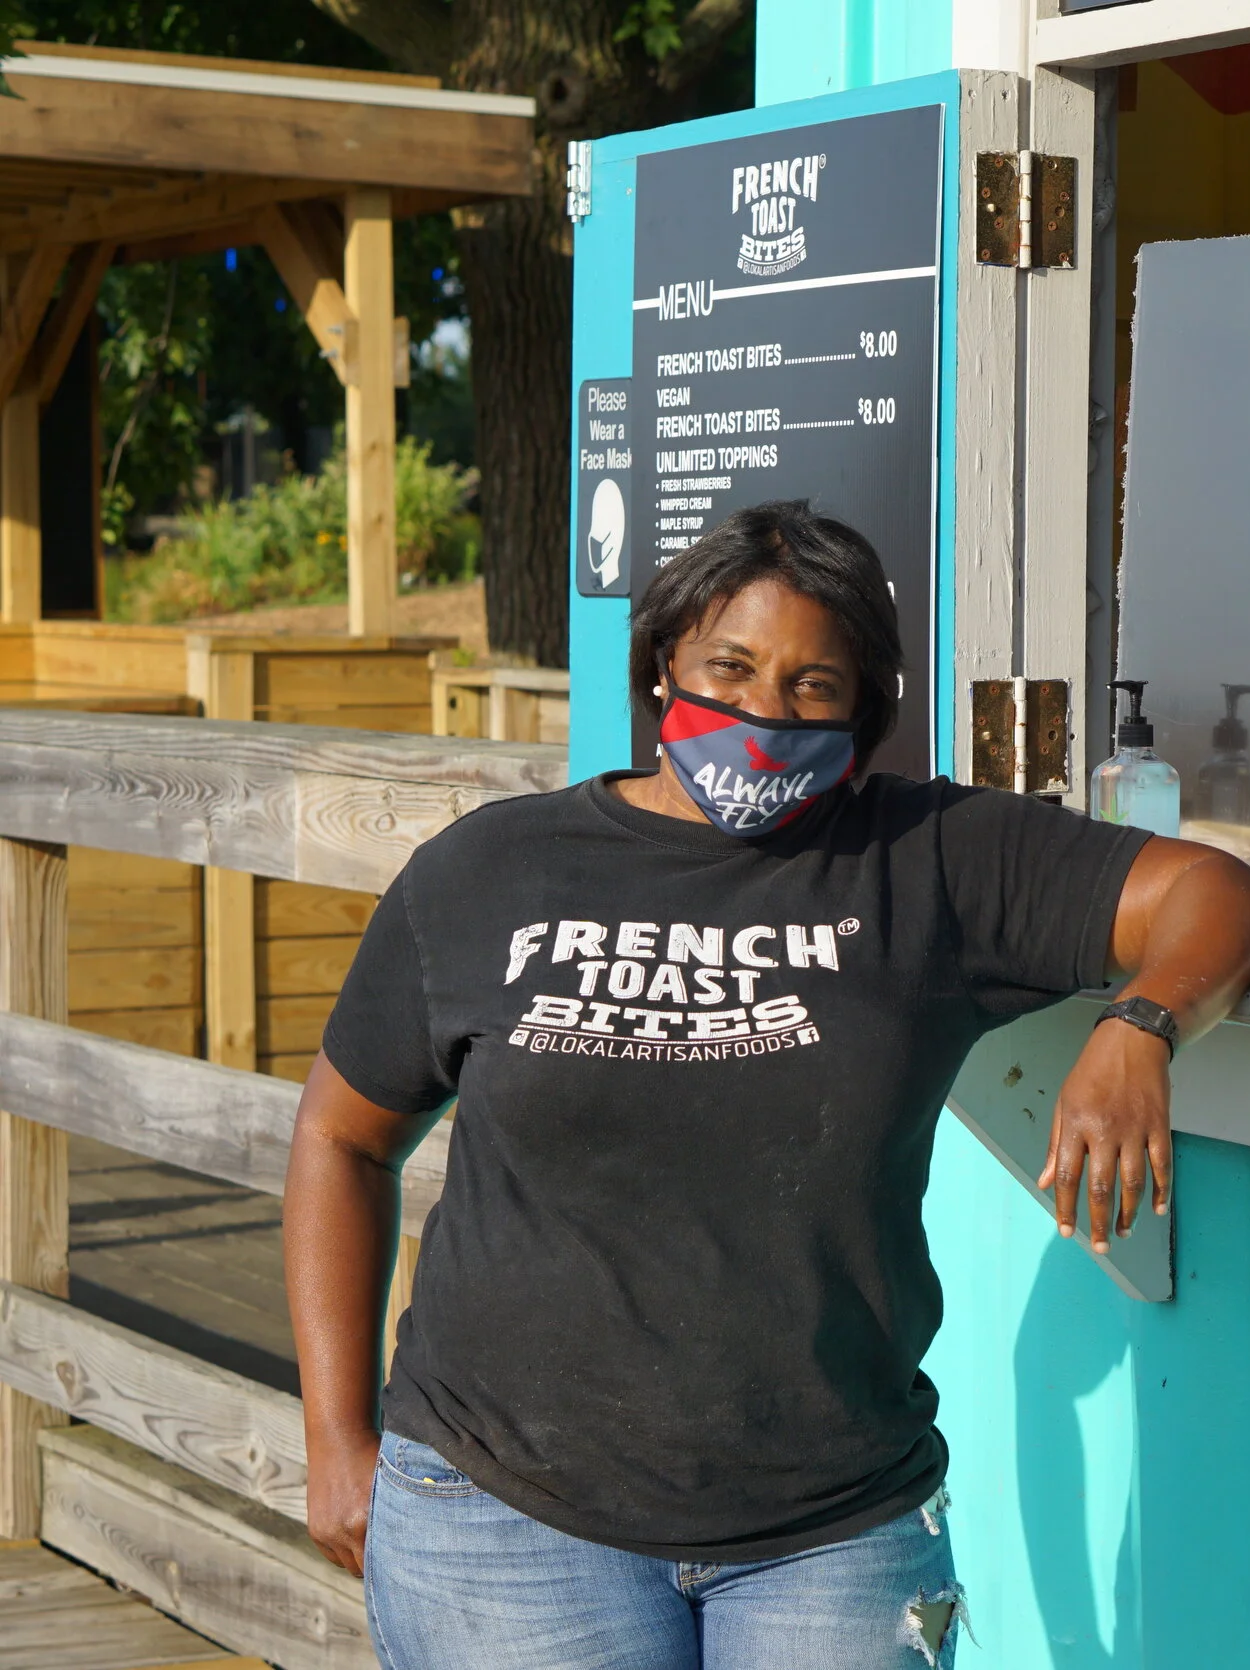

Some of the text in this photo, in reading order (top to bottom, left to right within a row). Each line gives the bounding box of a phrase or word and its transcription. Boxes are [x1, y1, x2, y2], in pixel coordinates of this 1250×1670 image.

[732, 155, 819, 215] FRENCH
[751, 196, 796, 236] TOAST
[740, 226, 805, 261] BITES
[743, 253, 801, 276] @LOKALARTISANFOODS
[658, 279, 714, 321] MENU
[657, 330, 898, 377] FRENCH TOAST BITES $8.00
[588, 387, 627, 412] Please
[656, 387, 691, 408] VEGAN
[589, 420, 625, 441] Wear a
[656, 397, 896, 439] FRENCH TOAST BITES $8.00
[580, 449, 605, 470] Face
[656, 444, 778, 473] UNLIMITED TOPPINGS
[661, 476, 732, 492] FRESH STRAWBERRIES
[660, 497, 712, 511] WHIPPED CREAM
[660, 517, 704, 530] MAPLE SYRUP
[660, 537, 690, 549] CARAMEL
[716, 801, 783, 830] FLY
[503, 920, 840, 985] FRENCH
[577, 961, 761, 1004] TOAST
[521, 995, 808, 1039] BITES
[530, 1032, 796, 1062] @LOKALARTISANFOODS
